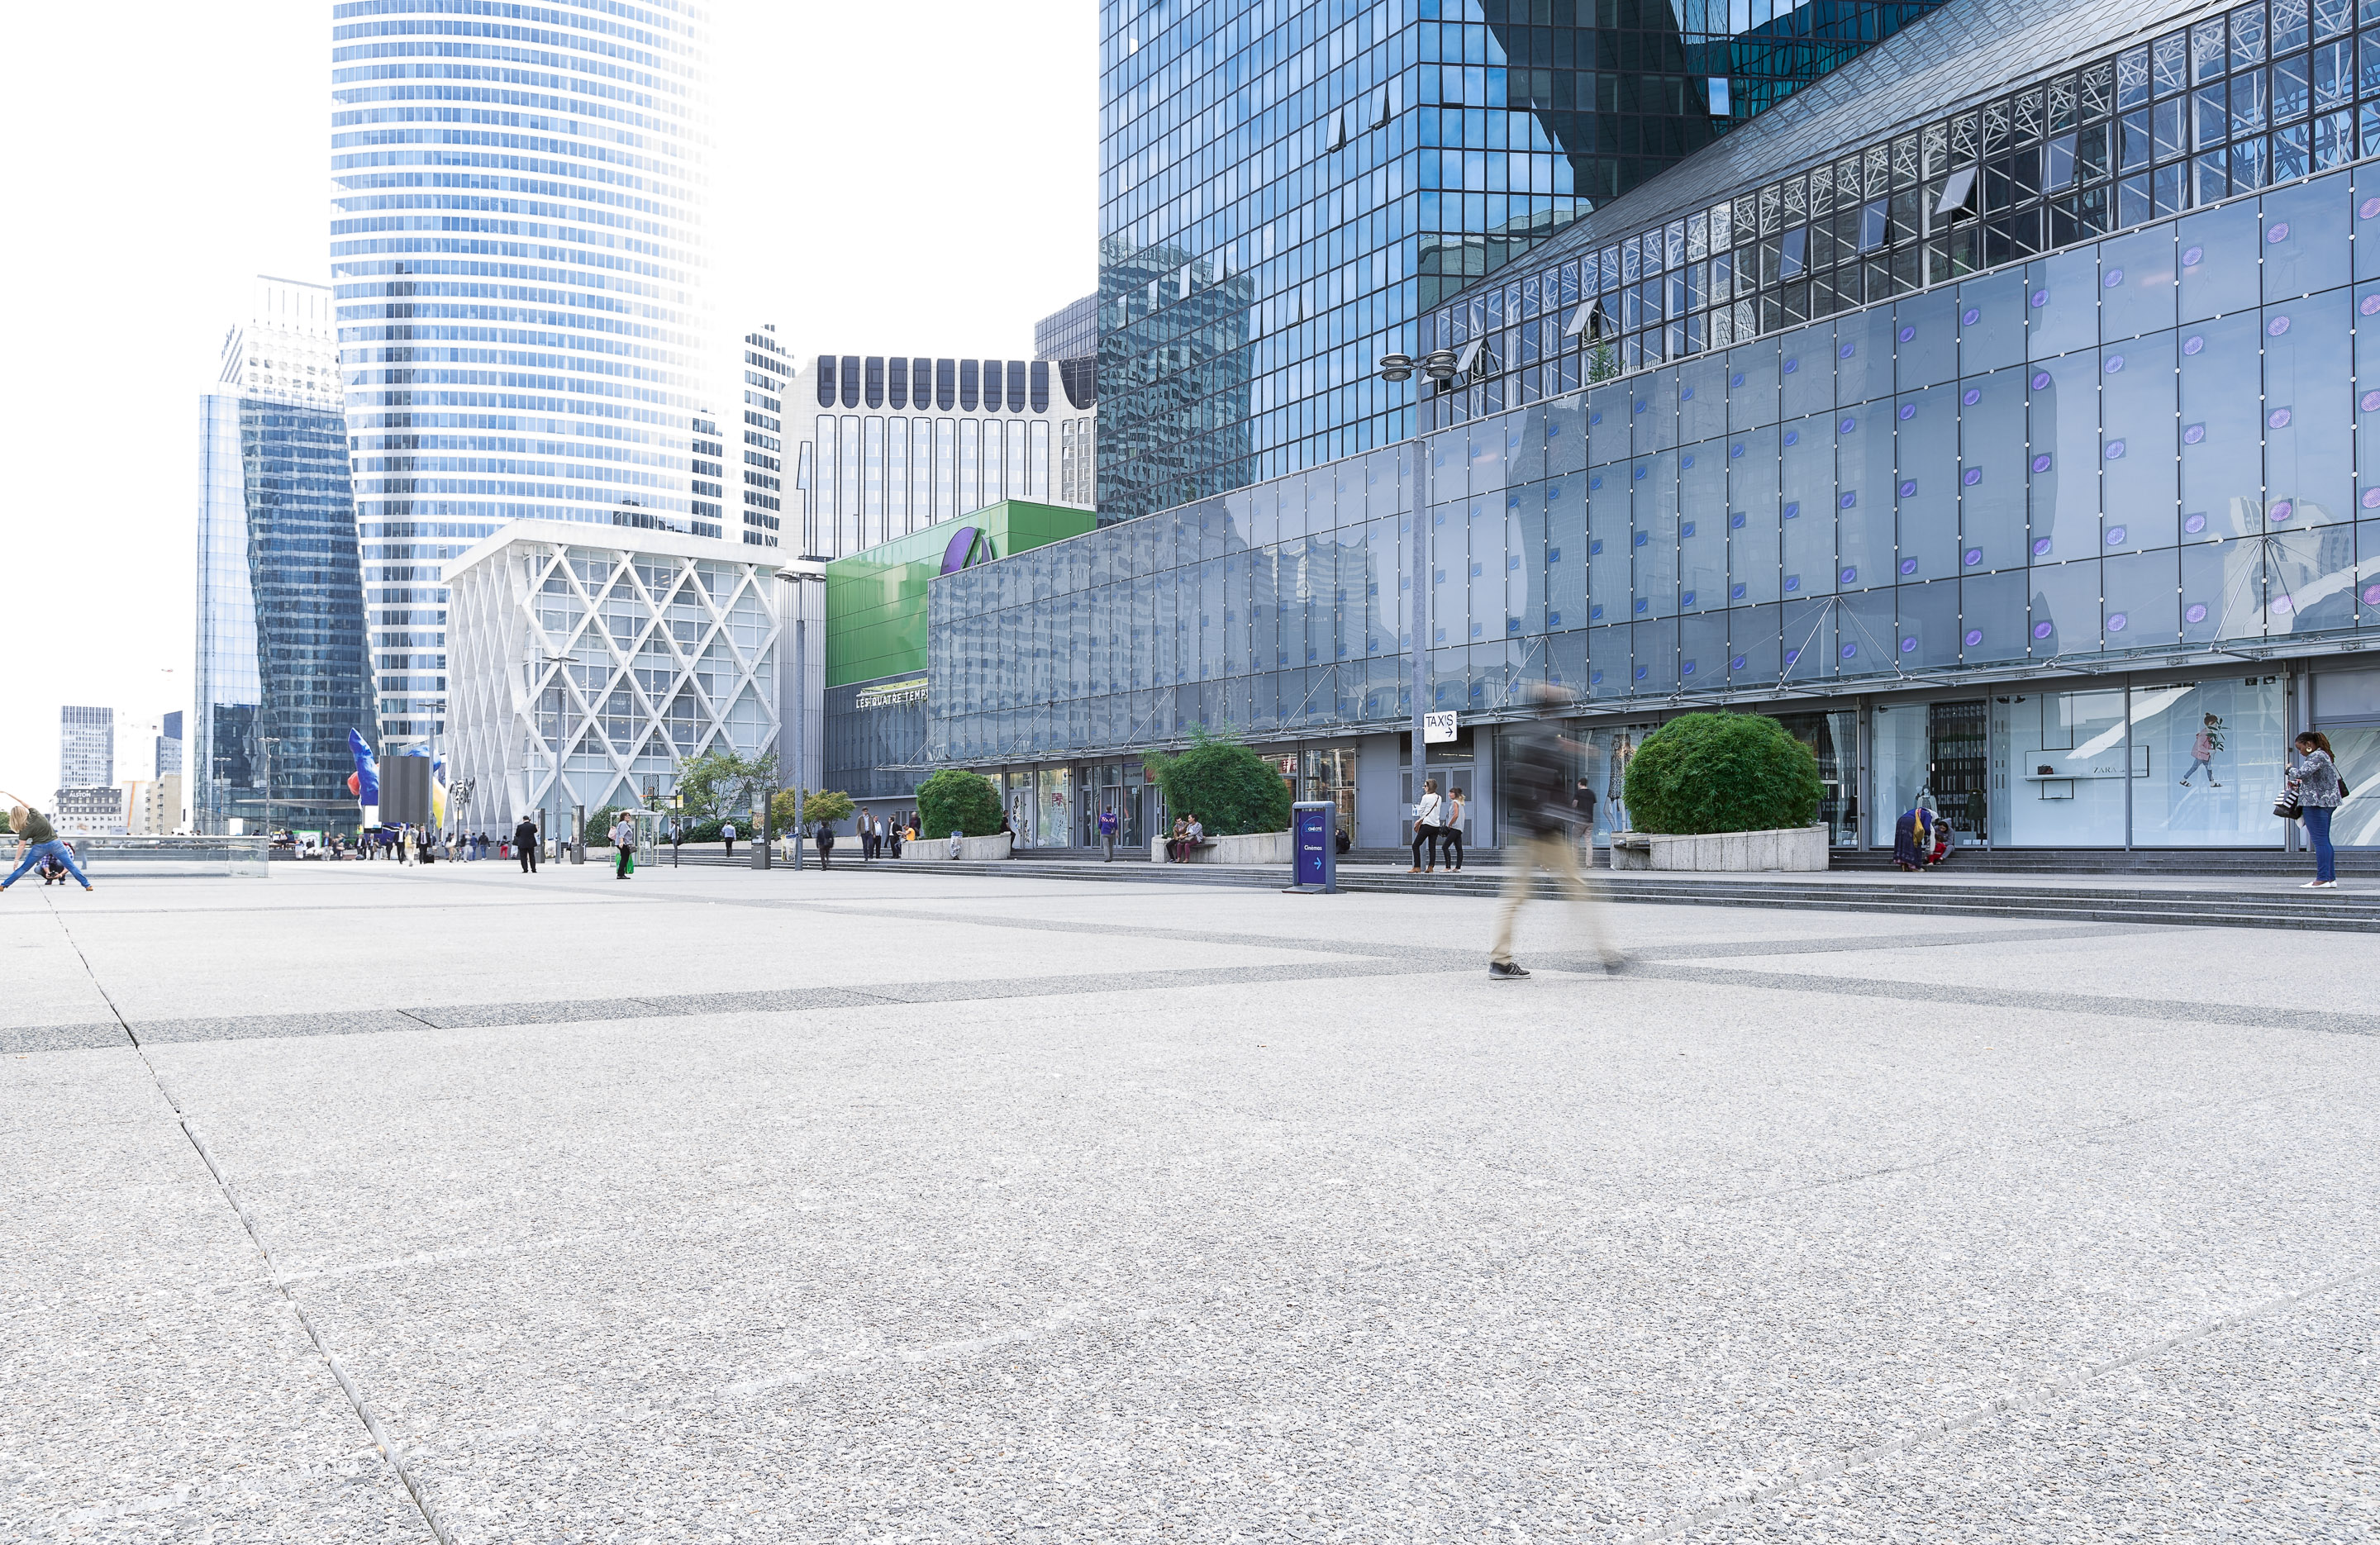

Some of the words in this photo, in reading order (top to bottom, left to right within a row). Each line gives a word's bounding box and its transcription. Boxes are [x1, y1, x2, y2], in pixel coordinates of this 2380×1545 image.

[856, 698, 869, 709] LES
[872, 693, 902, 706] QUATRE
[1426, 714, 1454, 727] TAXIS
